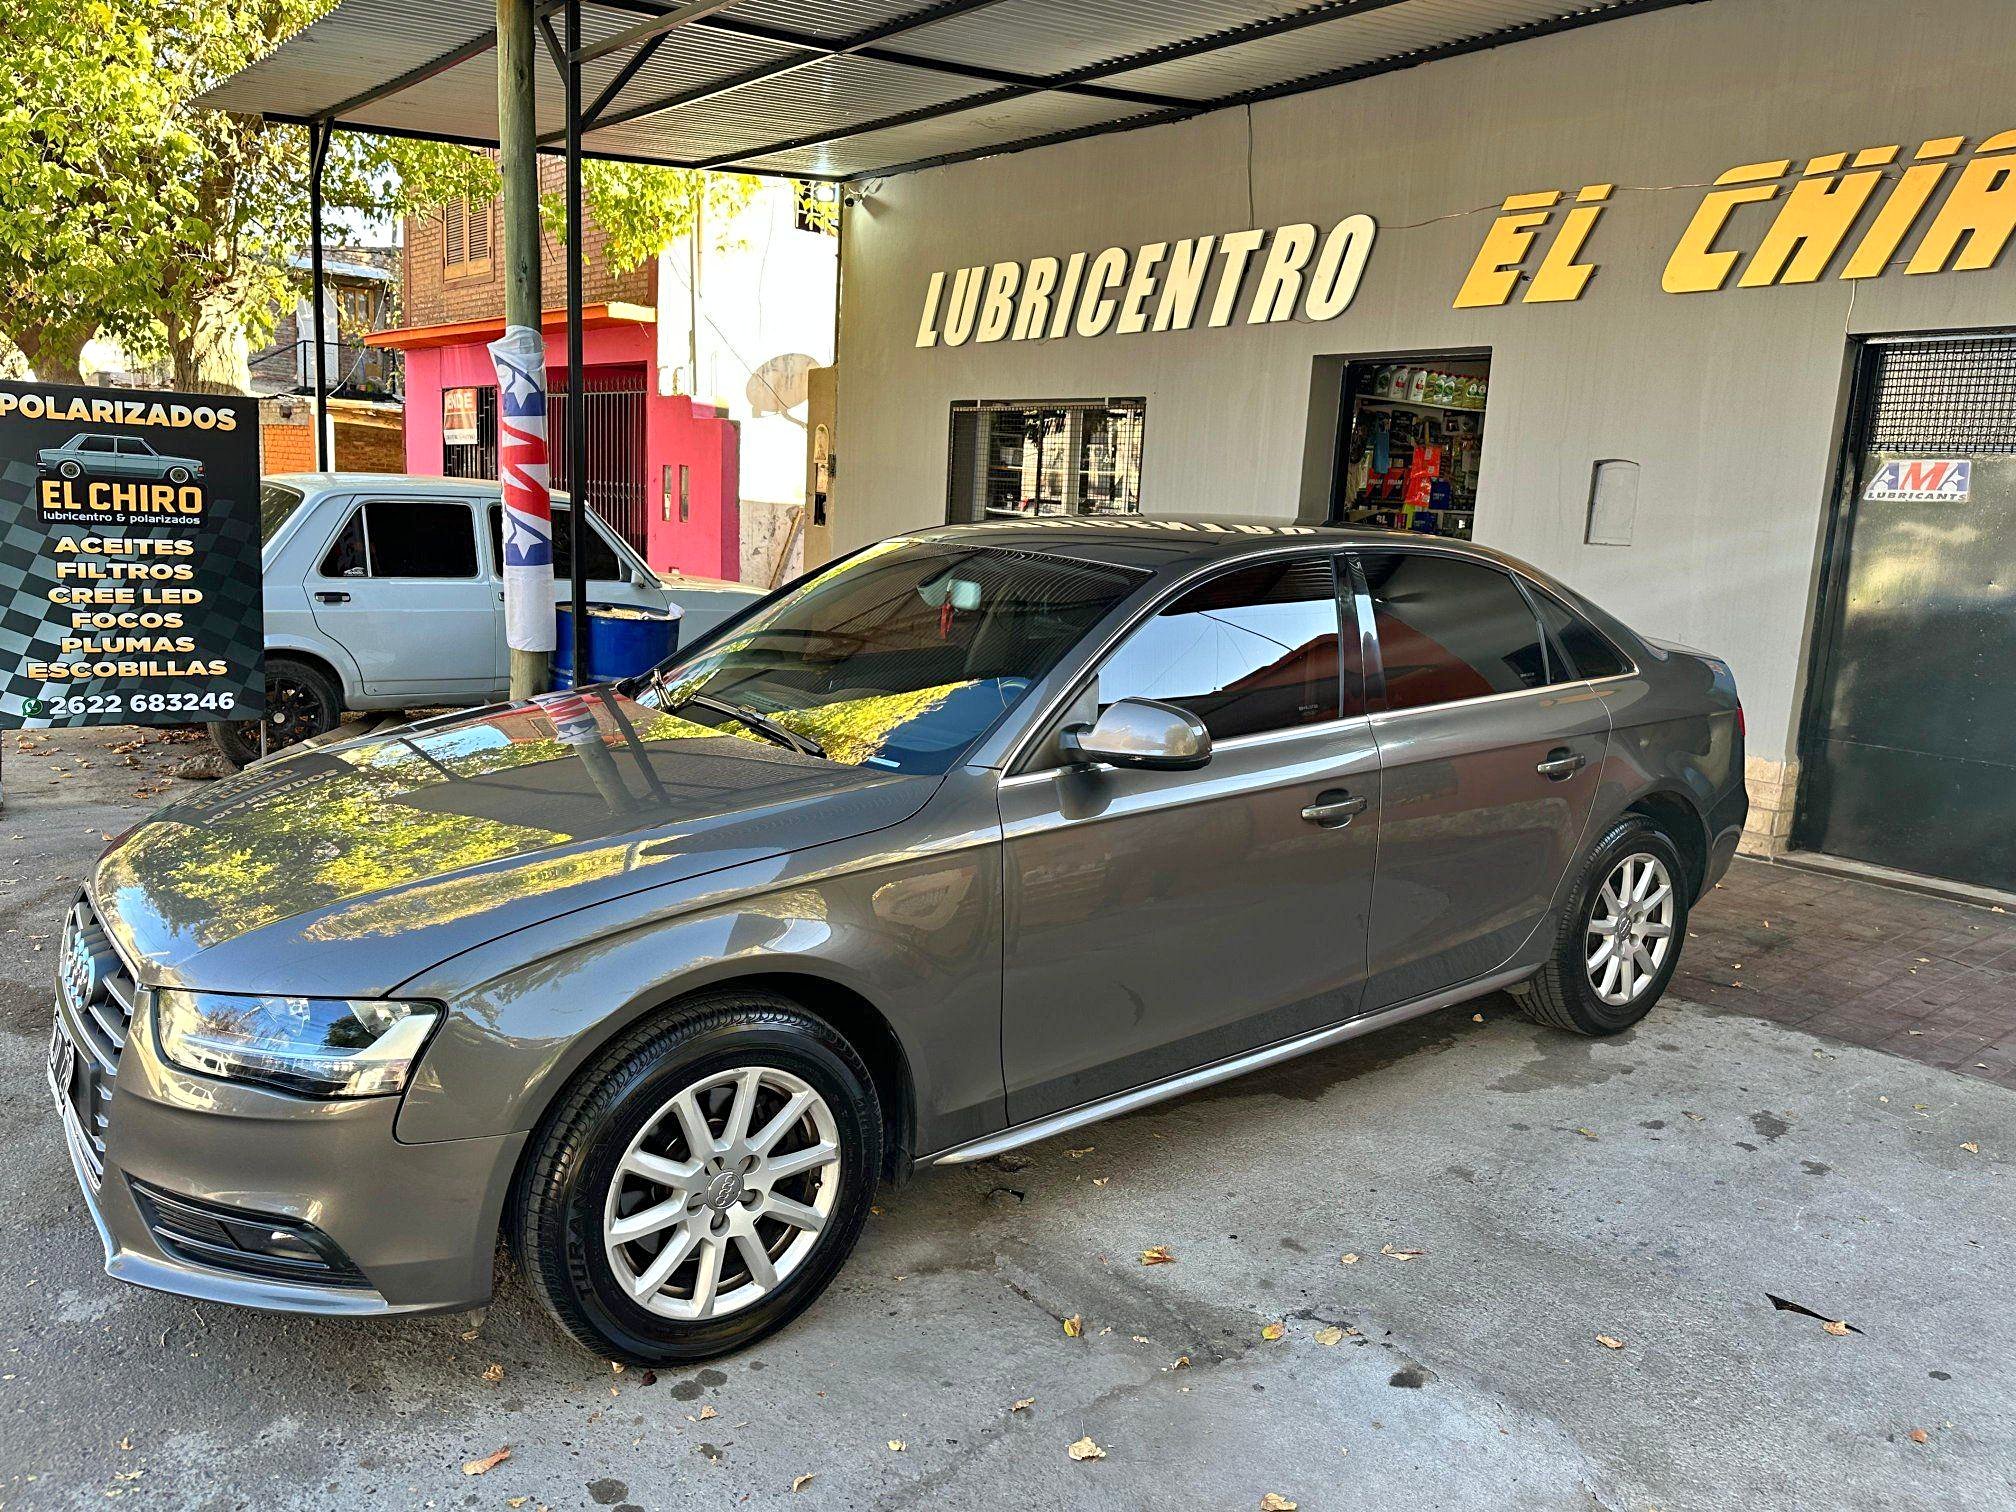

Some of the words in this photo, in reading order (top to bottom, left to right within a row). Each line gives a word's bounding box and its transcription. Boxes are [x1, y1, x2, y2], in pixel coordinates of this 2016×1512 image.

[1452, 183, 1614, 309] EL
[915, 213, 1377, 348] LUBRICENTRO
[0, 392, 238, 431] POLARIZADOS
[1869, 461, 1969, 491] AMA
[41, 480, 82, 510] EL
[88, 481, 203, 514] CHIRO
[1867, 492, 1967, 501] LUBRICANTS
[43, 510, 113, 522] lubricentro
[116, 512, 126, 522] &
[129, 513, 201, 525] polarizados
[53, 536, 195, 556] ACEITES
[55, 562, 194, 581] FILTROS
[47, 586, 136, 604] CREE
[142, 588, 204, 604] LED
[71, 611, 184, 629] FOCOS
[60, 636, 196, 654] PLUMAS
[27, 659, 229, 679] ESCOBILLAS
[49, 694, 123, 715] 2622
[129, 692, 236, 713] 683246
